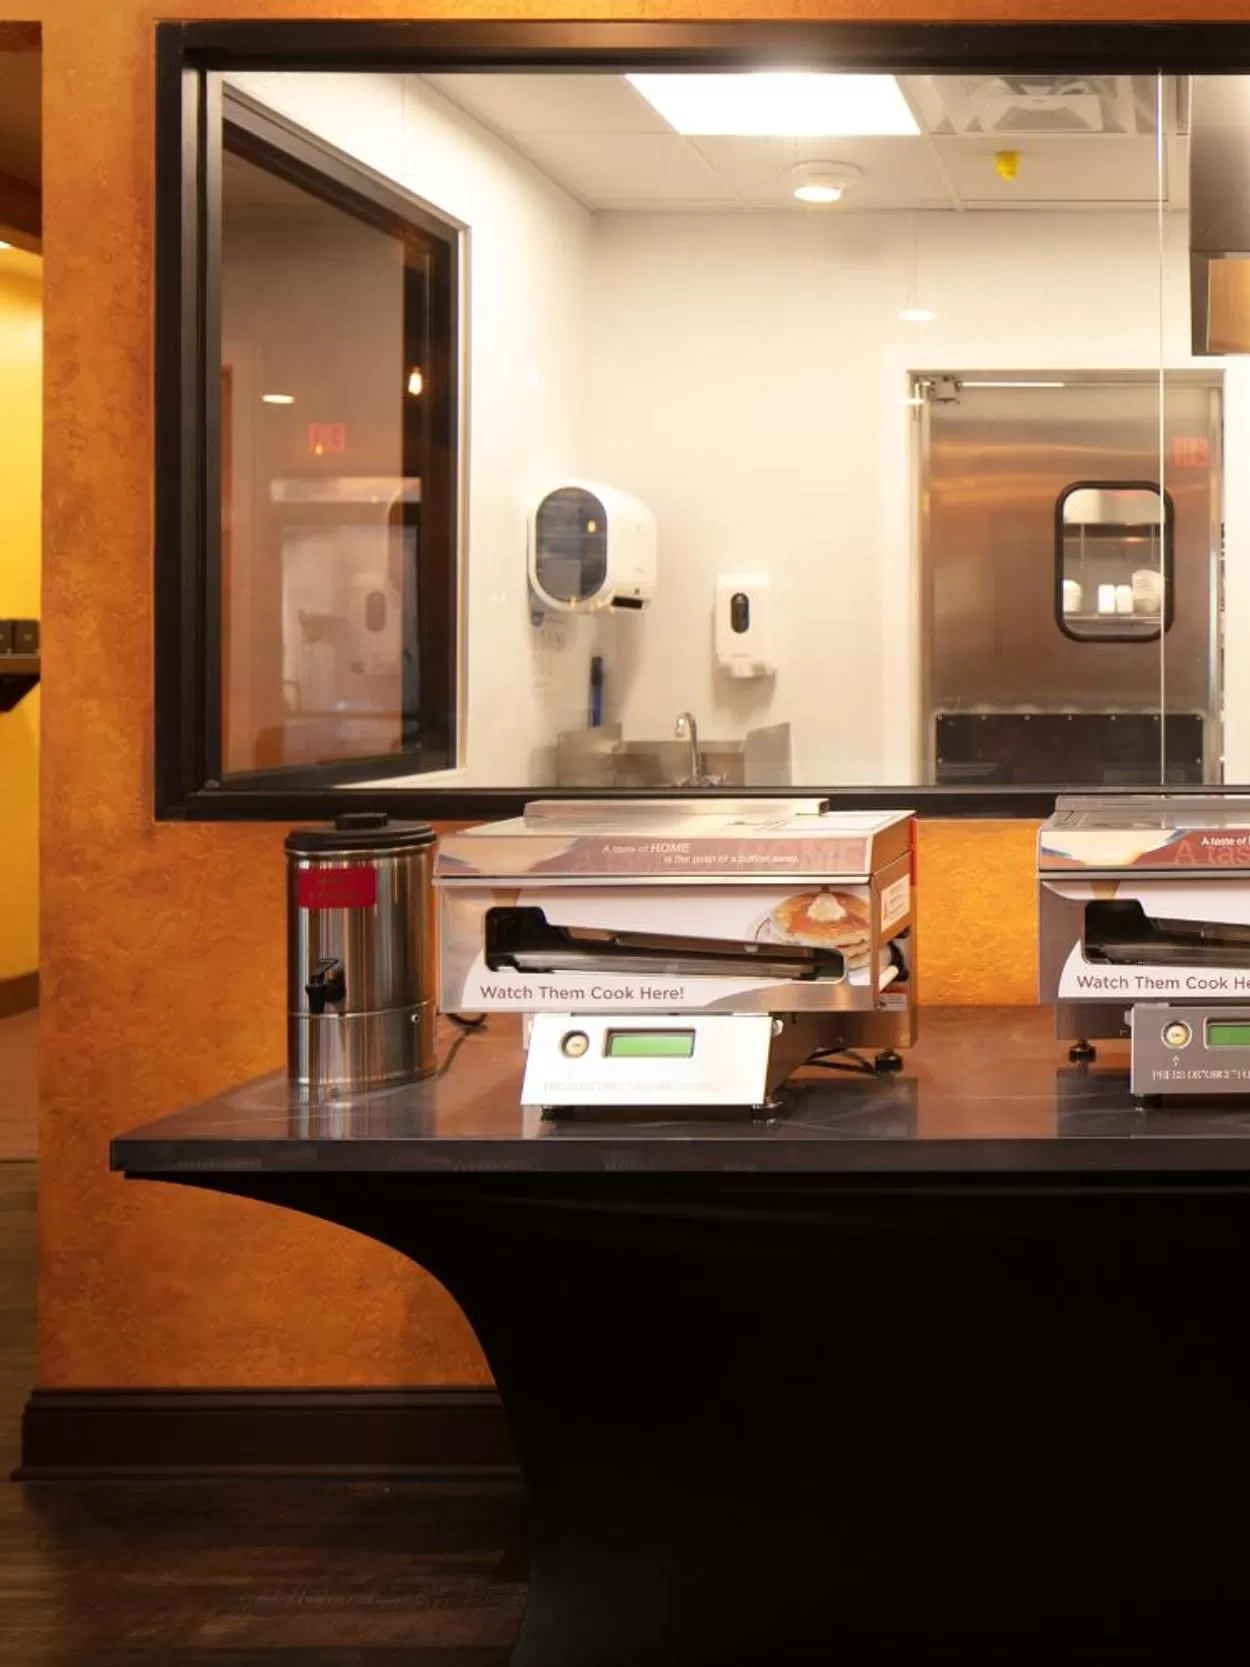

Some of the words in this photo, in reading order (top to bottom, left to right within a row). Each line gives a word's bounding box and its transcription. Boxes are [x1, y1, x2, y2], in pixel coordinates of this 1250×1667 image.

[1201, 836, 1210, 846] A
[1236, 835, 1247, 846] of
[651, 842, 691, 854] HOME
[1076, 975, 1130, 990] Watch
[1135, 975, 1180, 990] Them
[1186, 976, 1229, 990] Cook
[480, 985, 533, 1000] Watch
[538, 985, 585, 1000] Them
[591, 986, 634, 1000] Cook
[640, 986, 684, 1001] Here!
